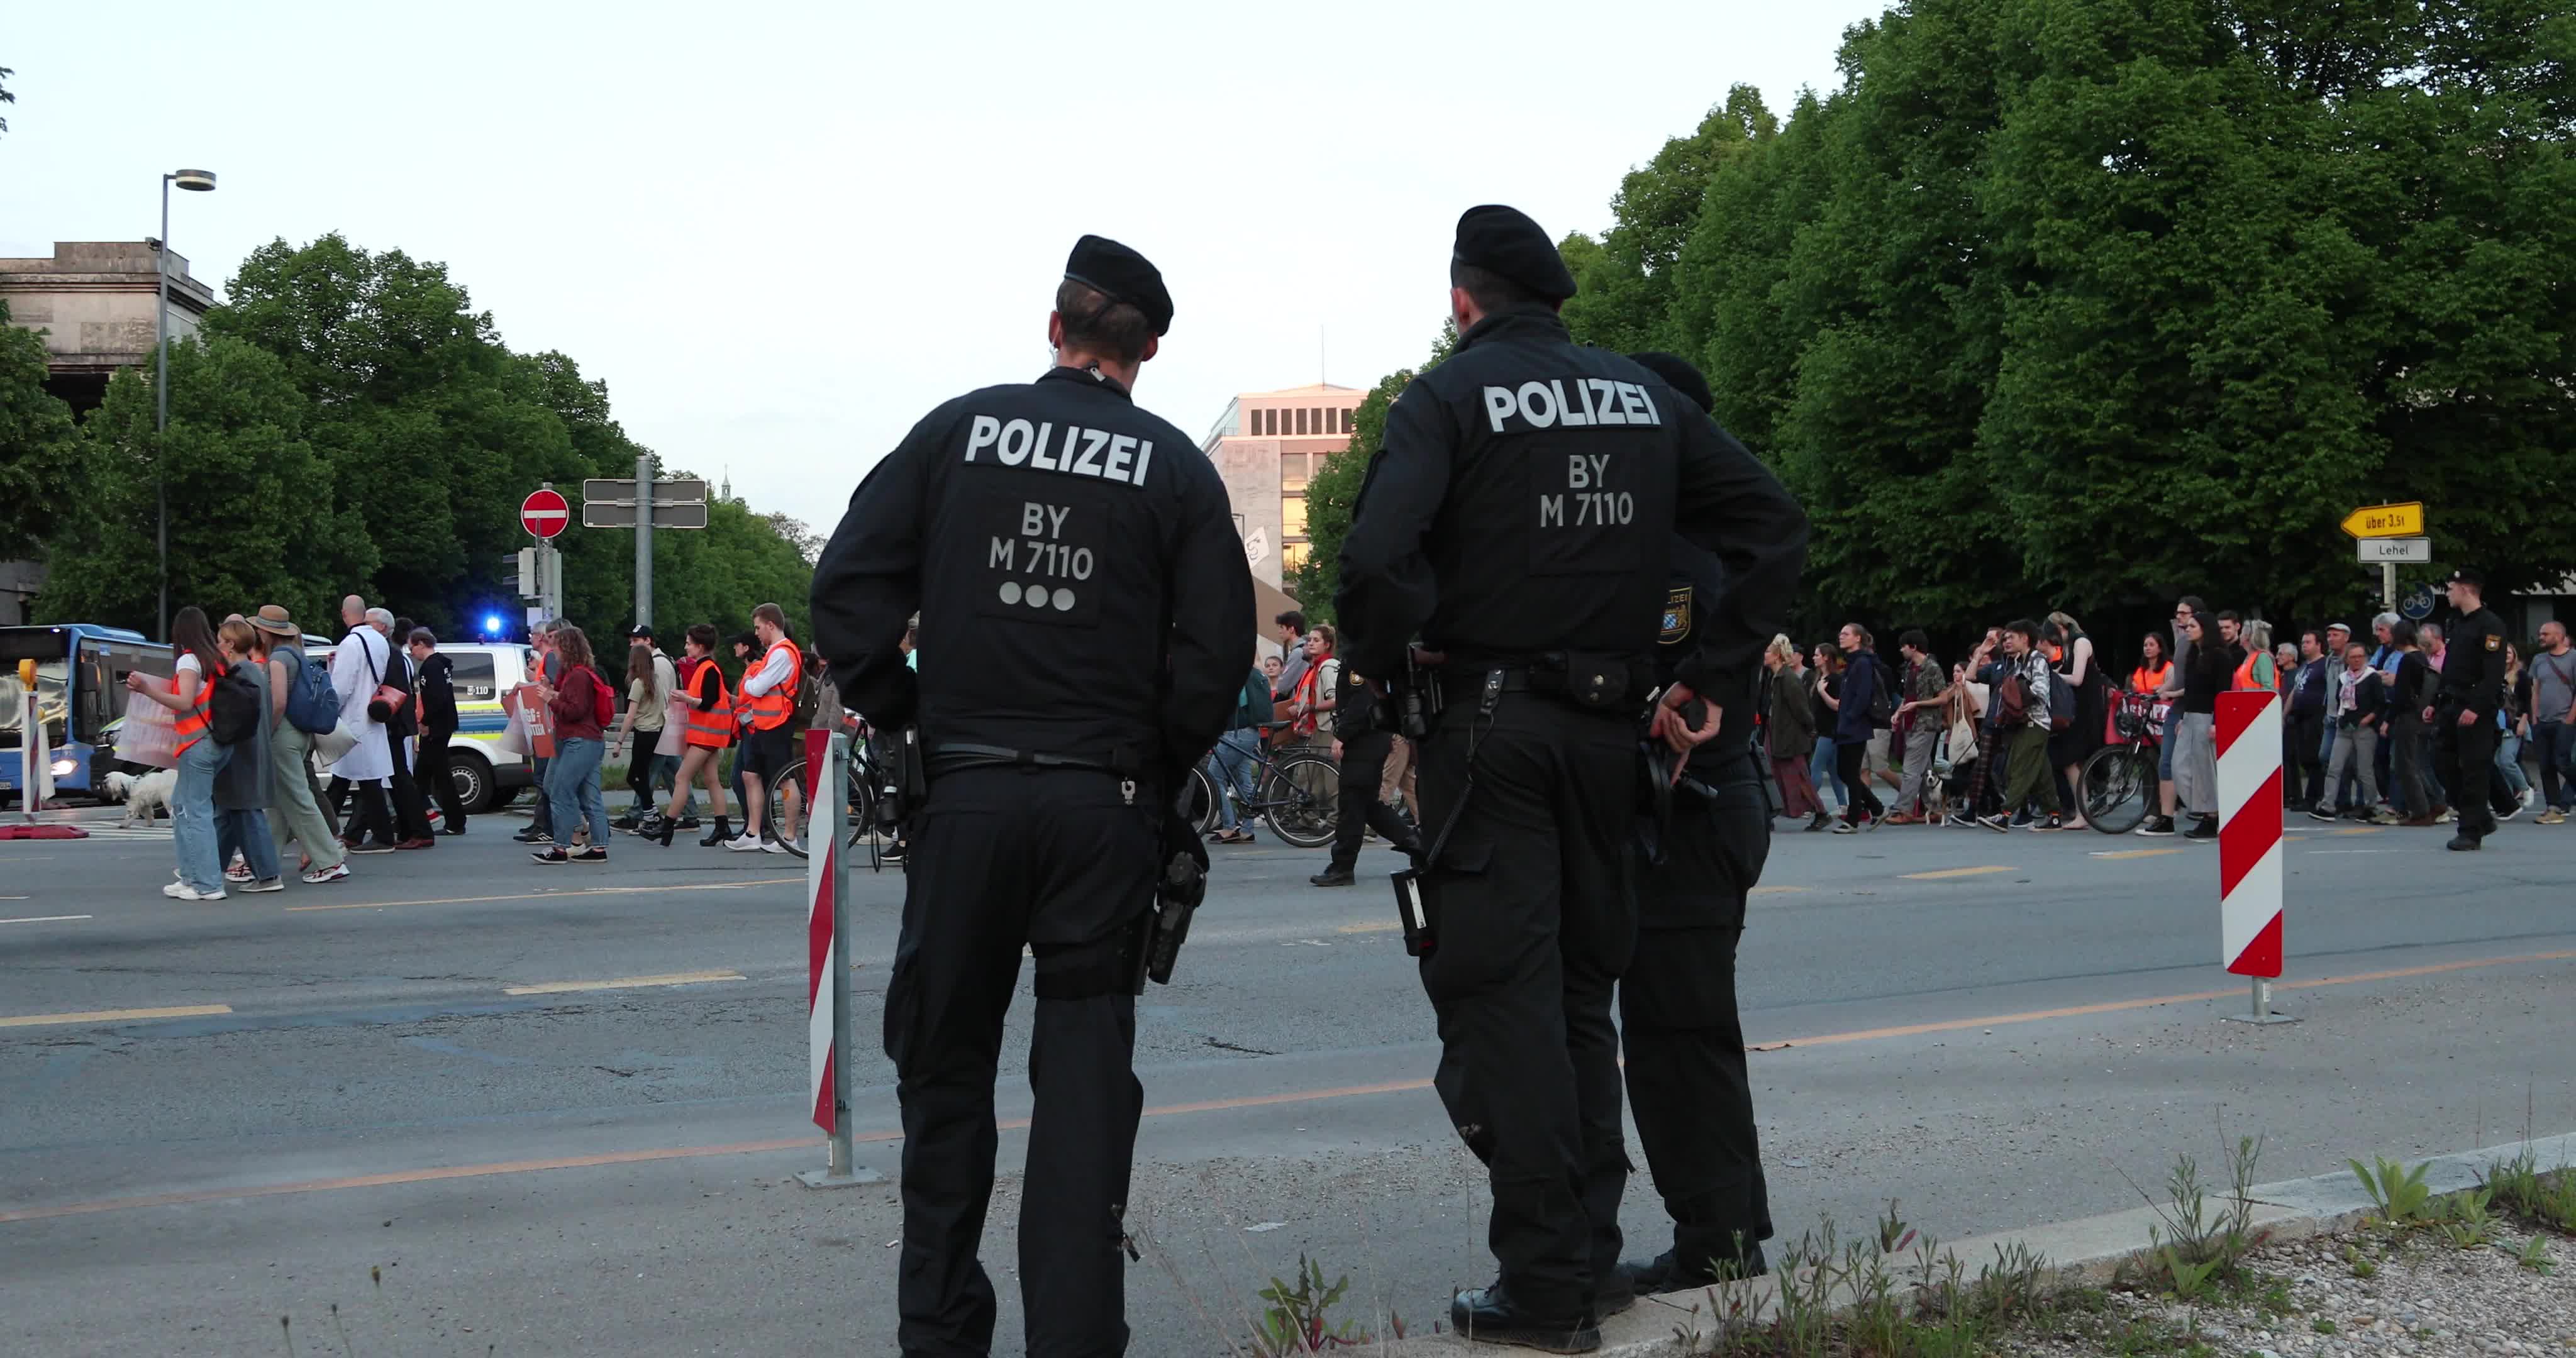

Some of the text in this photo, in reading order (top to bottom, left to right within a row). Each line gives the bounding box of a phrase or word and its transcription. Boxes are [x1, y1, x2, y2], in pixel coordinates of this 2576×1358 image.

[1484, 378, 1662, 432] POLIZEI
[965, 415, 1153, 487] POLIZEI
[1569, 454, 1610, 489] BY
[1021, 502, 1070, 539] BY
[1540, 485, 1634, 527] M 7110
[2366, 516, 2386, 529] über
[989, 536, 1093, 580] M 7110
[2379, 544, 2409, 556] Lehel
[475, 686, 489, 695] 110
